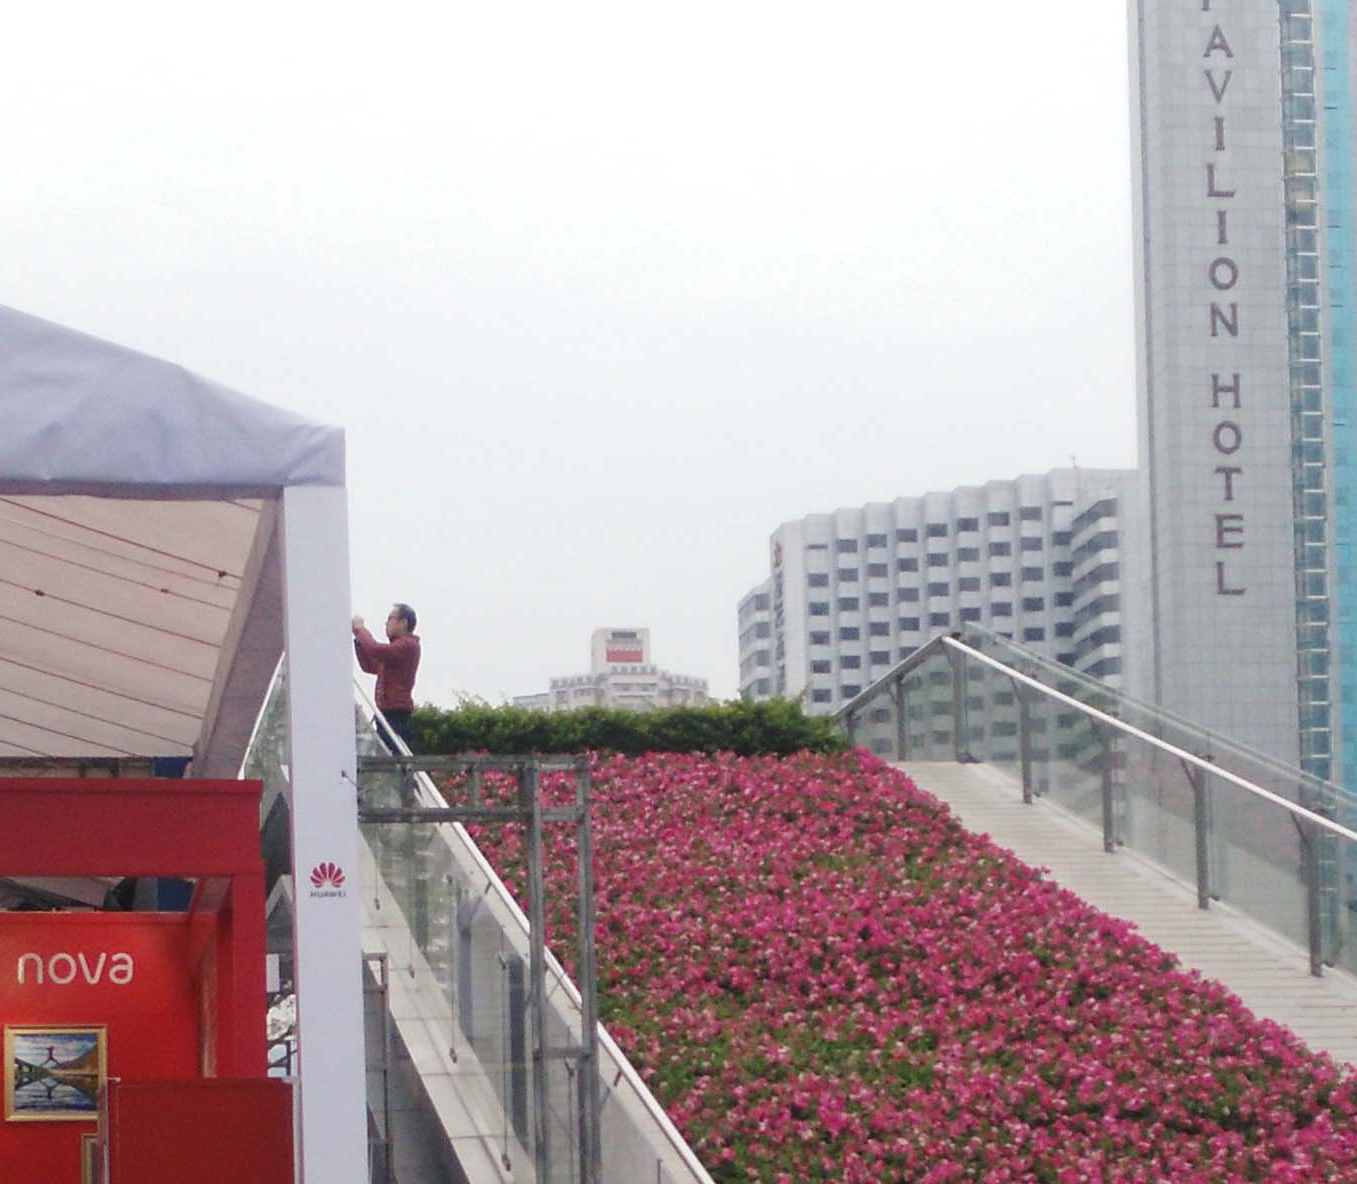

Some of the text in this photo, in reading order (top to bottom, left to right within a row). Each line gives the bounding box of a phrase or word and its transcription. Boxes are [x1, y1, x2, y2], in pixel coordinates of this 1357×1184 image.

[1201, 0, 1247, 597] AVILION HOTEL
[310, 890, 347, 898] HUAWEI
[17, 951, 134, 986] nova
